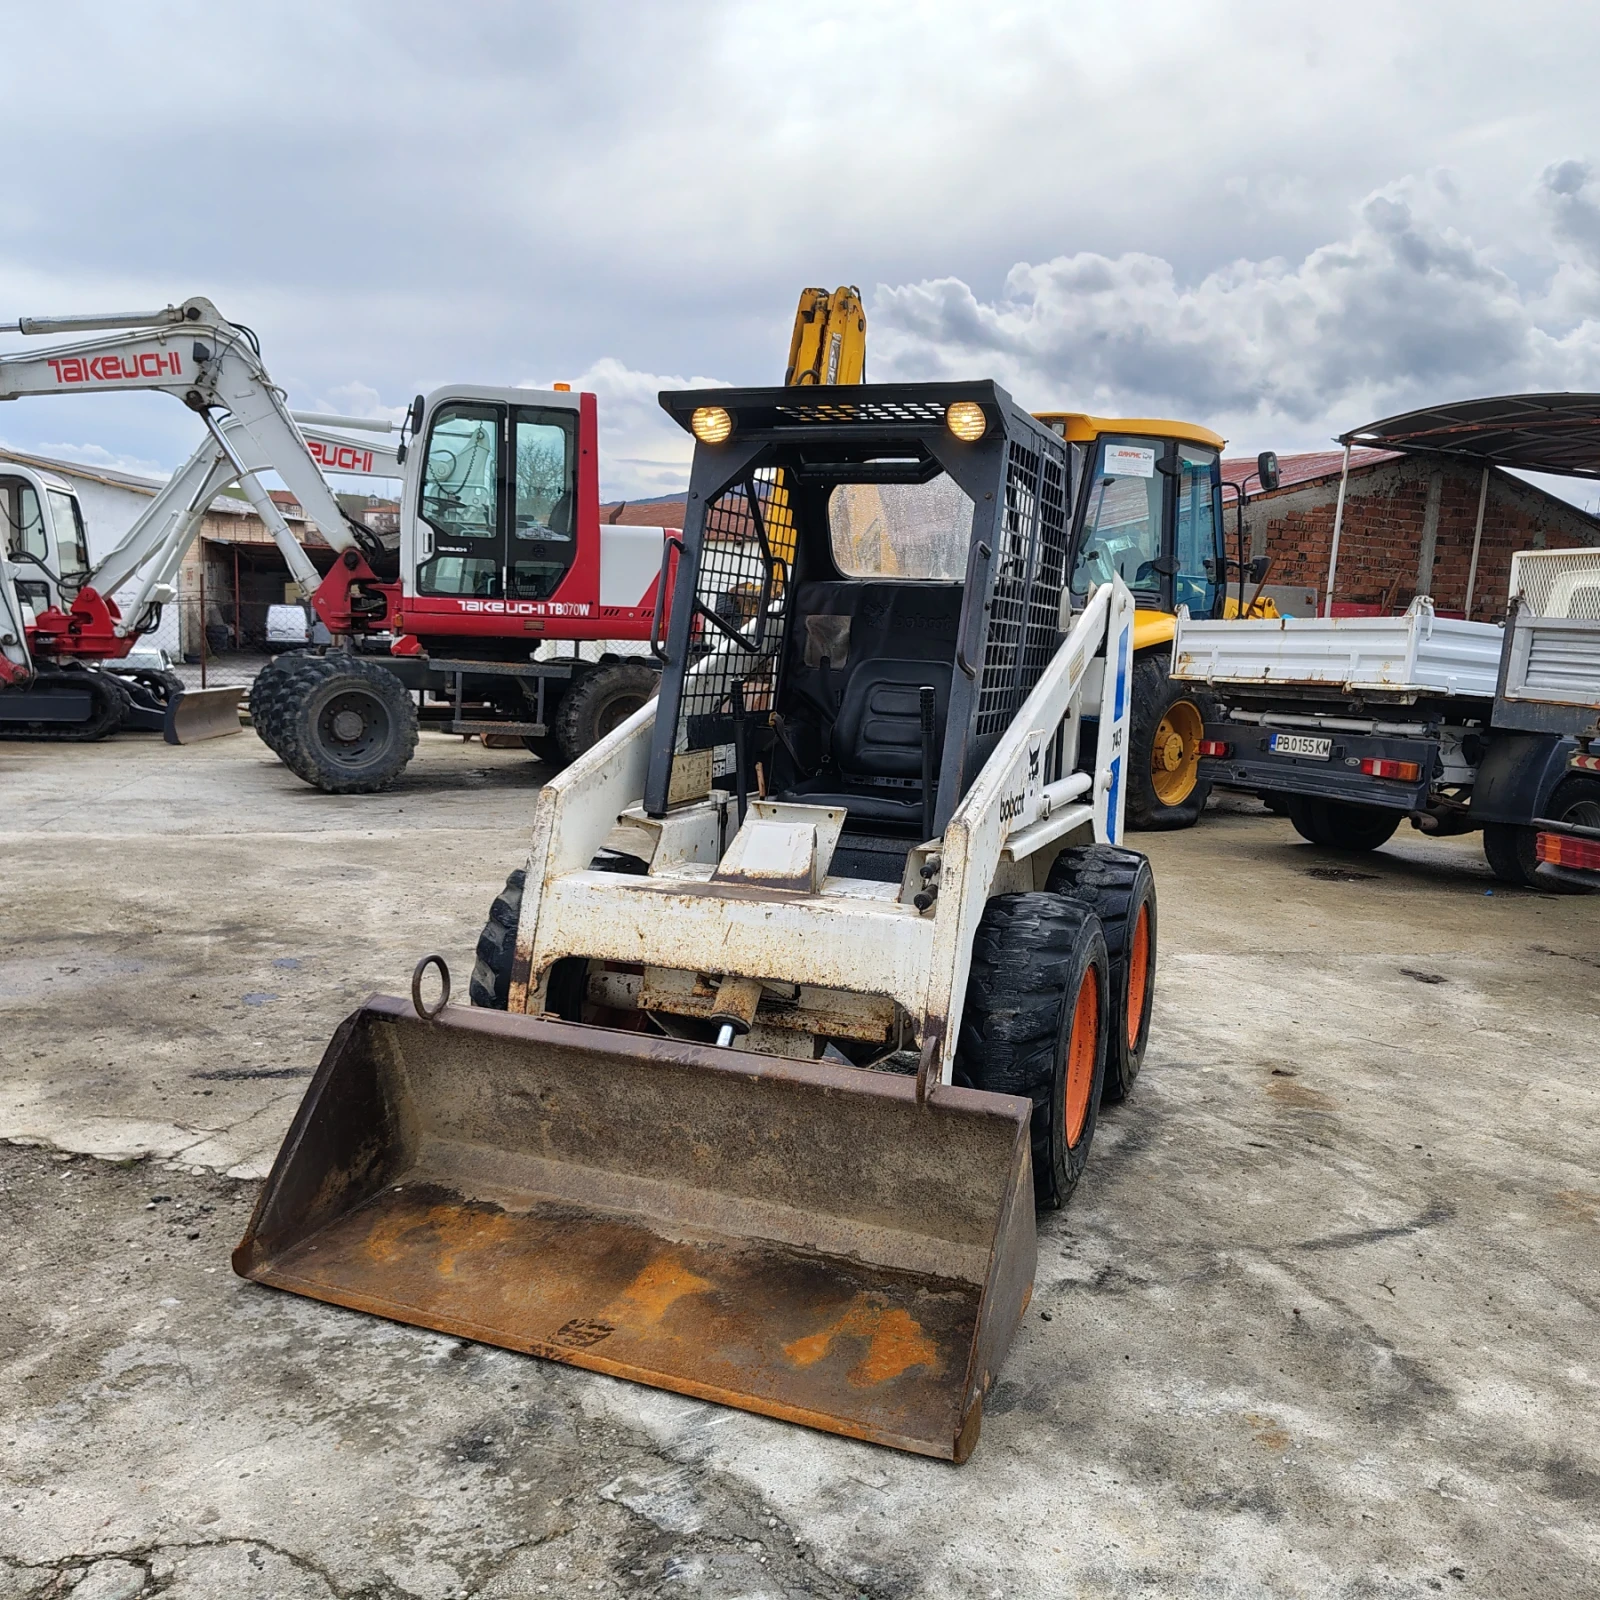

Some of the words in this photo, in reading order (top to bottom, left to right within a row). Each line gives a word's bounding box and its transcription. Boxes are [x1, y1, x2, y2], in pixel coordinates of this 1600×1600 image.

[47, 352, 181, 383] TAKEUCHI
[307, 442, 374, 472] EUCHI
[457, 601, 545, 614] TAKEUCHI
[548, 602, 590, 617] TB070W
[1112, 727, 1122, 752] 743
[999, 788, 1025, 823] bobcat
